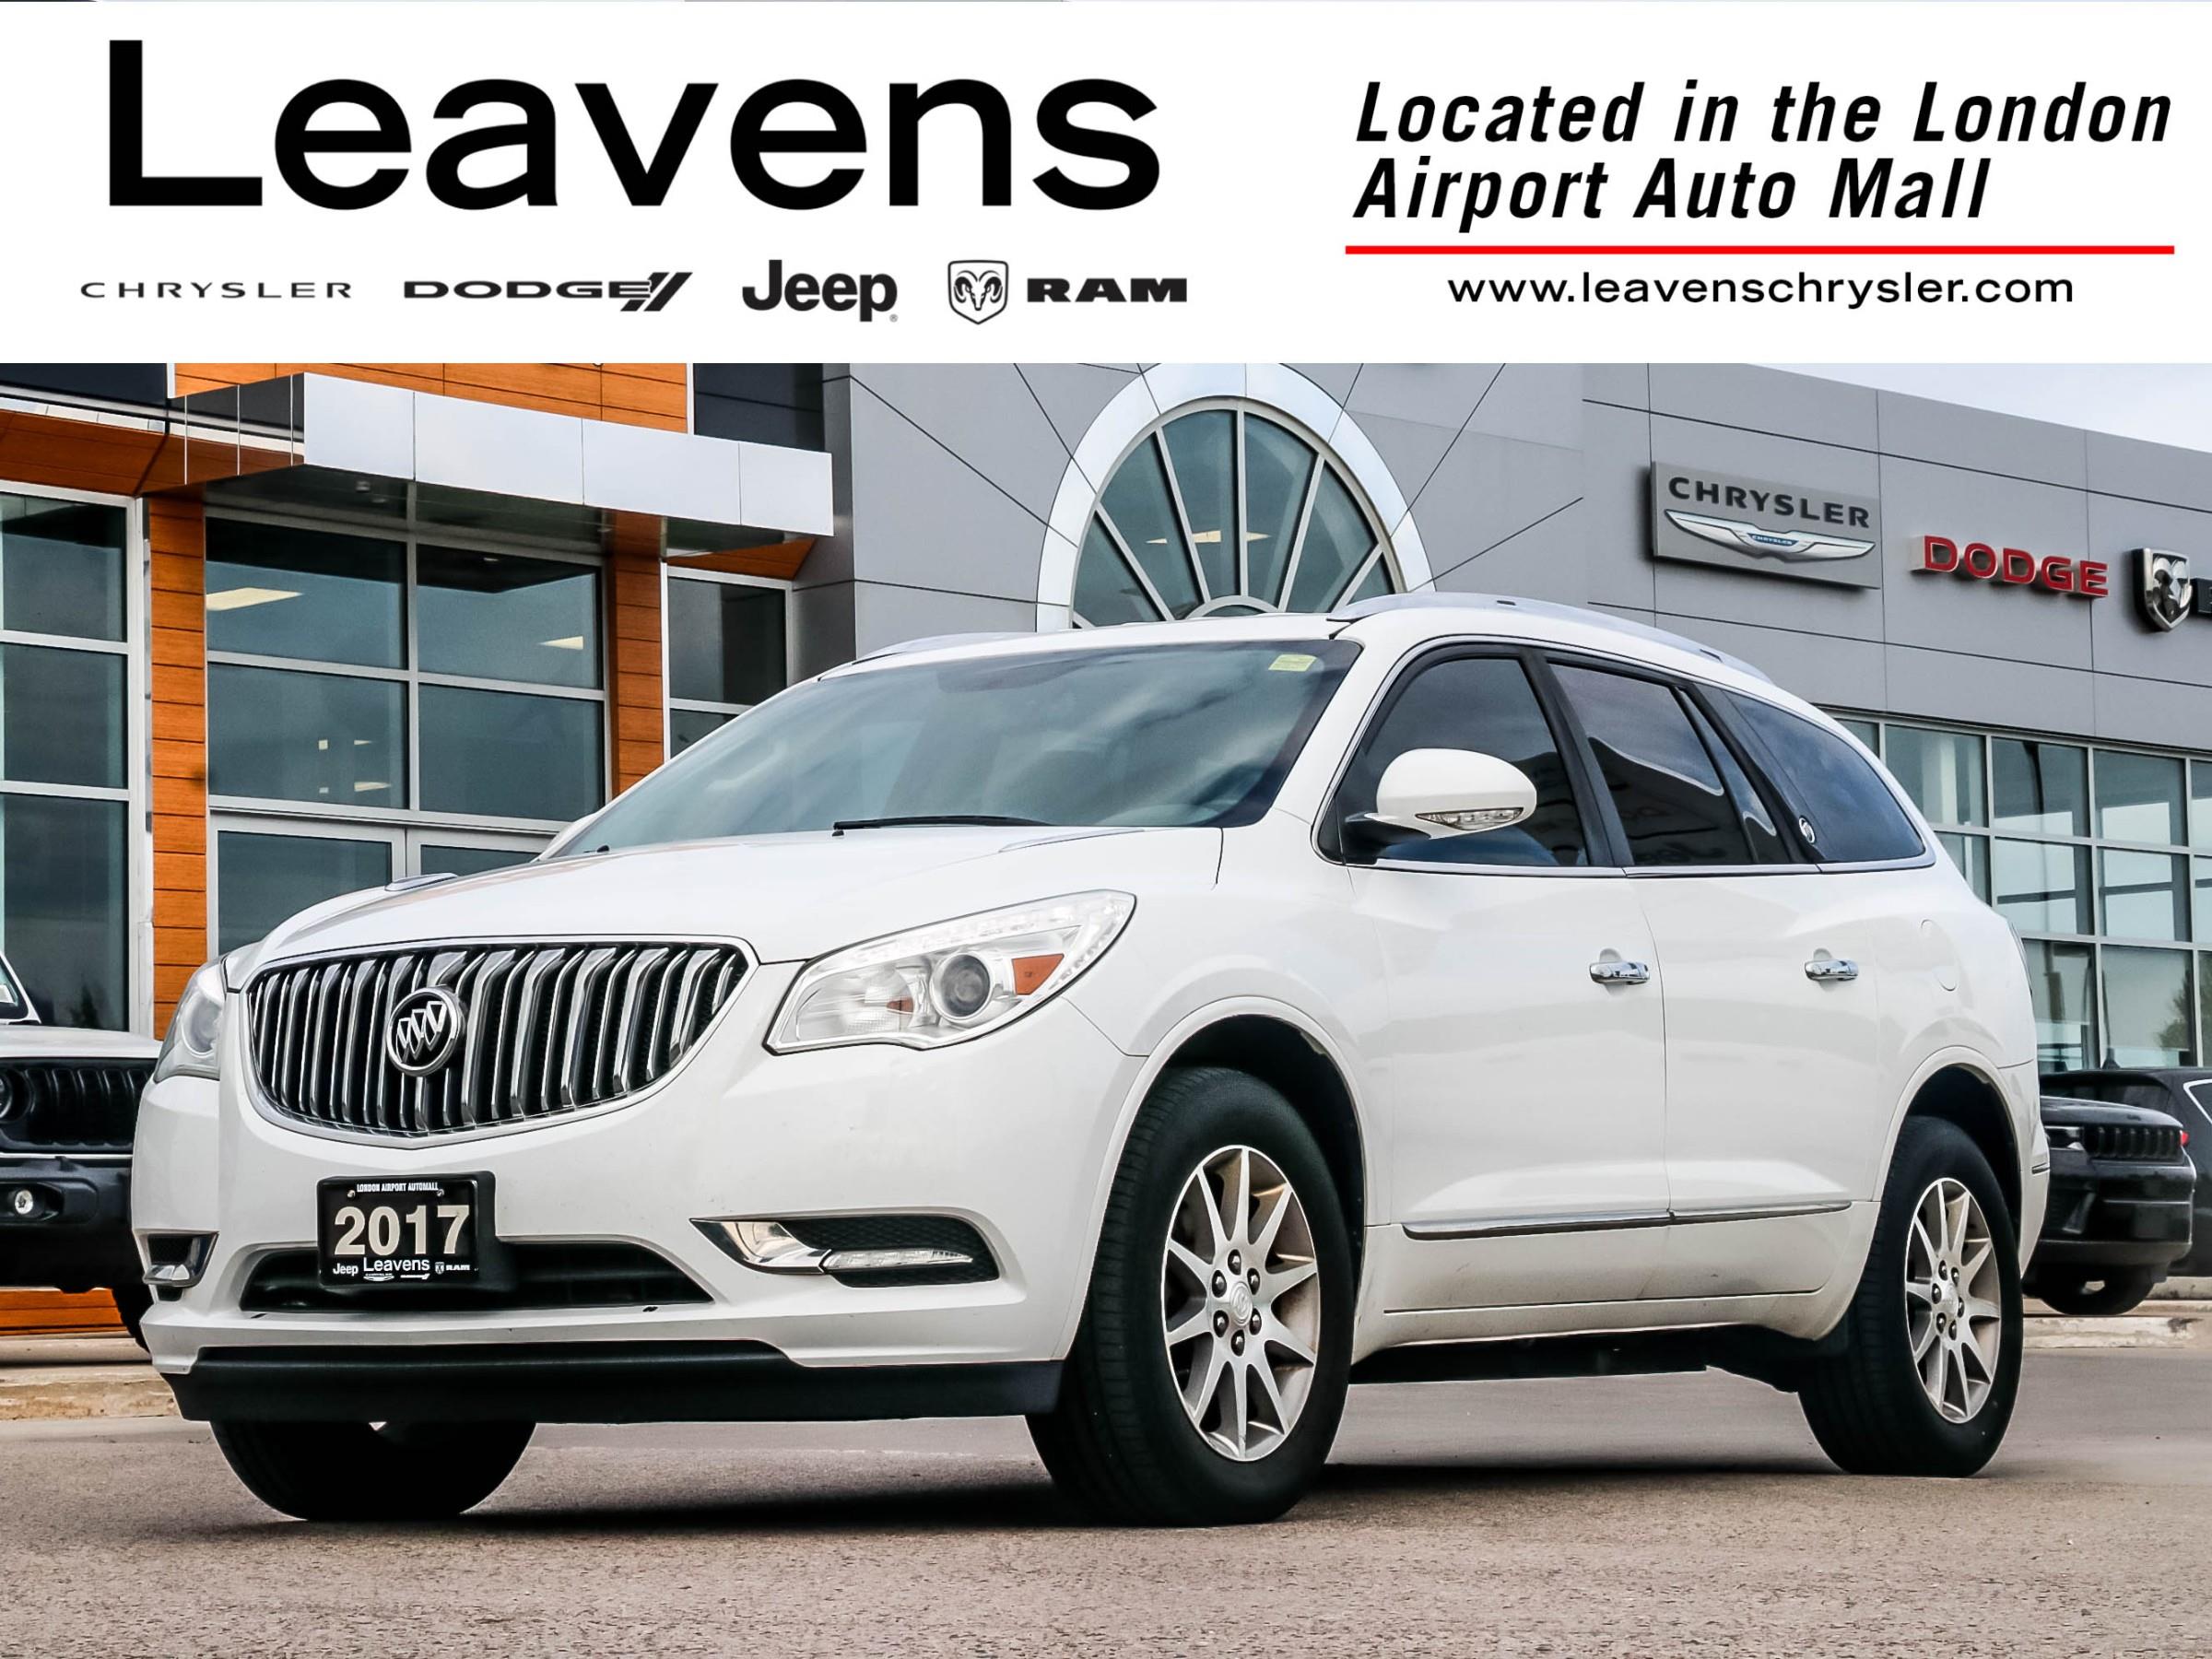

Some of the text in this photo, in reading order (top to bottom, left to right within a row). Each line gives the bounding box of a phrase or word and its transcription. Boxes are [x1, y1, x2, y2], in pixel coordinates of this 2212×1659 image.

[1668, 476, 1870, 529] CHRYSLER
[1923, 535, 2109, 597] DODGE
[357, 1182, 439, 1193] LONDON AIRPORT AUTOMALL
[334, 1205, 470, 1256] 2017
[332, 1256, 430, 1277] Jeep Leavens
